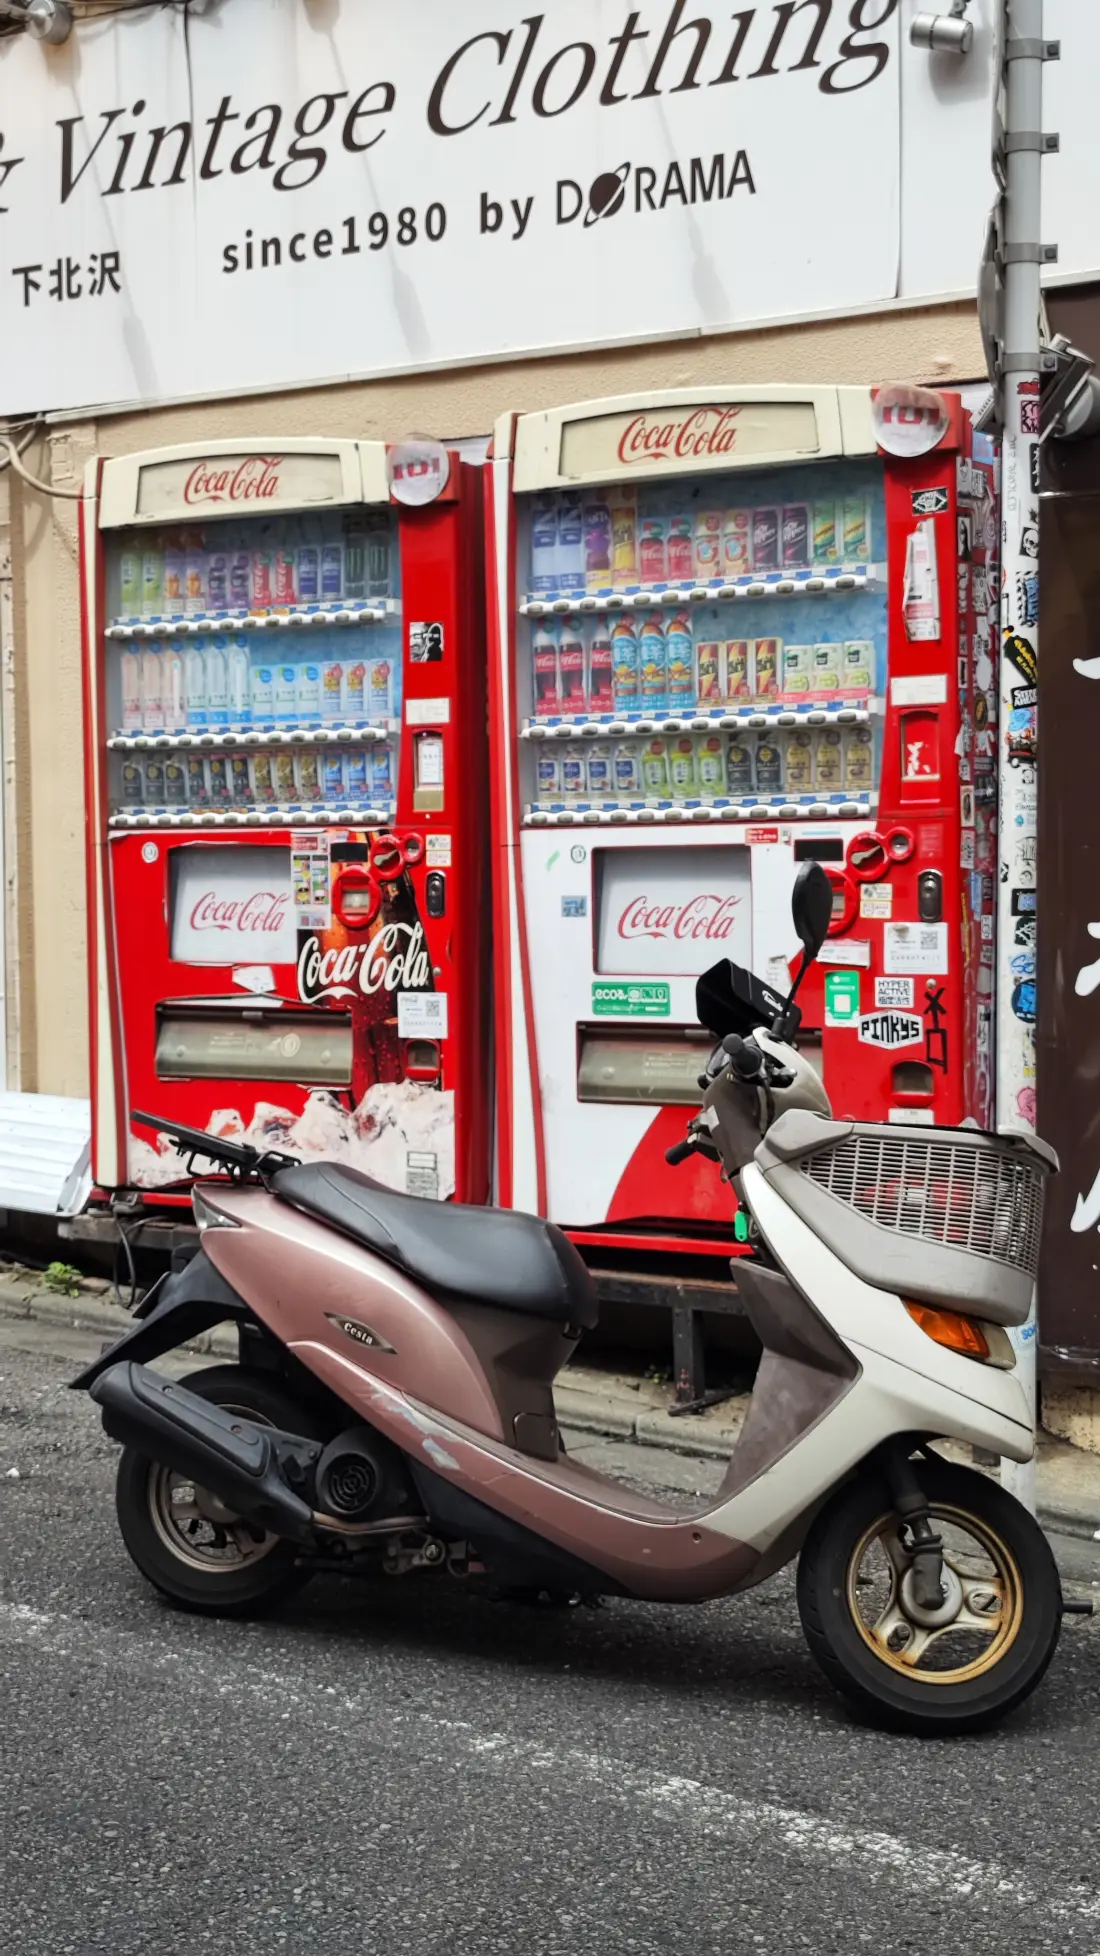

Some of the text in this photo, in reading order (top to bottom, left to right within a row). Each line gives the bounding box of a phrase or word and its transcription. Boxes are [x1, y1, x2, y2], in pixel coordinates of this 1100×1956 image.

[55, 82, 396, 204] Vintage
[427, 0, 899, 136] Clothing
[222, 202, 446, 273] since1980
[480, 192, 534, 240] by
[12, 250, 121, 307] 下北沢
[617, 406, 743, 464] Coca-Cola
[183, 455, 284, 505] Coca-Cola
[189, 890, 291, 933] Coca-Cola
[617, 894, 744, 940] Coca-Cola
[297, 921, 430, 1005] Coca-Cola
[878, 980, 910, 988] HYPER
[861, 1015, 920, 1043] PINKYS
[343, 1322, 373, 1345] Cesta
